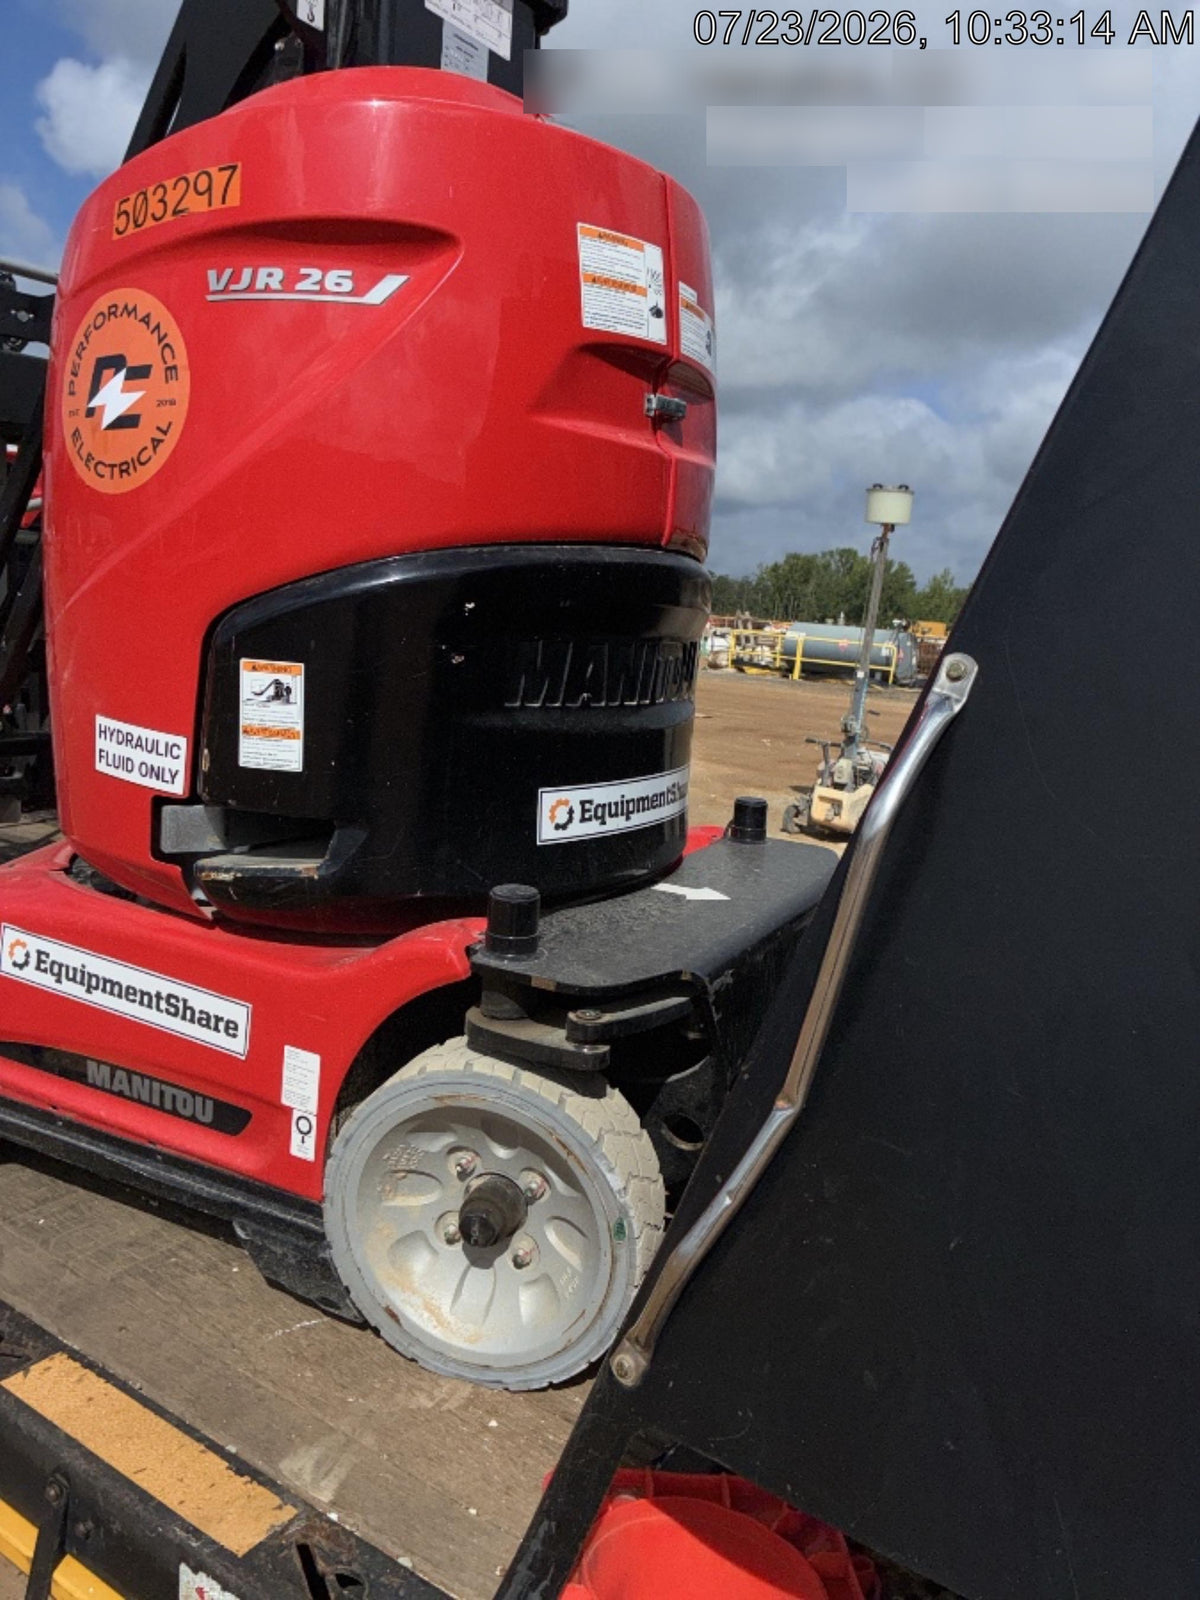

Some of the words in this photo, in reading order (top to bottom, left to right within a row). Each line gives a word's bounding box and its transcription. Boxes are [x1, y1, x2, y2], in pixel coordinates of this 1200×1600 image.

[114, 164, 239, 236] 503297
[206, 267, 285, 292] VJR
[295, 267, 353, 293] 26
[67, 302, 179, 397] PERFORMANCE
[70, 420, 173, 480] ELECTRICAL
[98, 723, 182, 760] HYDRAULIC
[98, 748, 135, 774] FLUID
[138, 761, 180, 785] ONLY
[34, 949, 239, 1038] EquipmentShare
[86, 1059, 214, 1124] MANITOU
